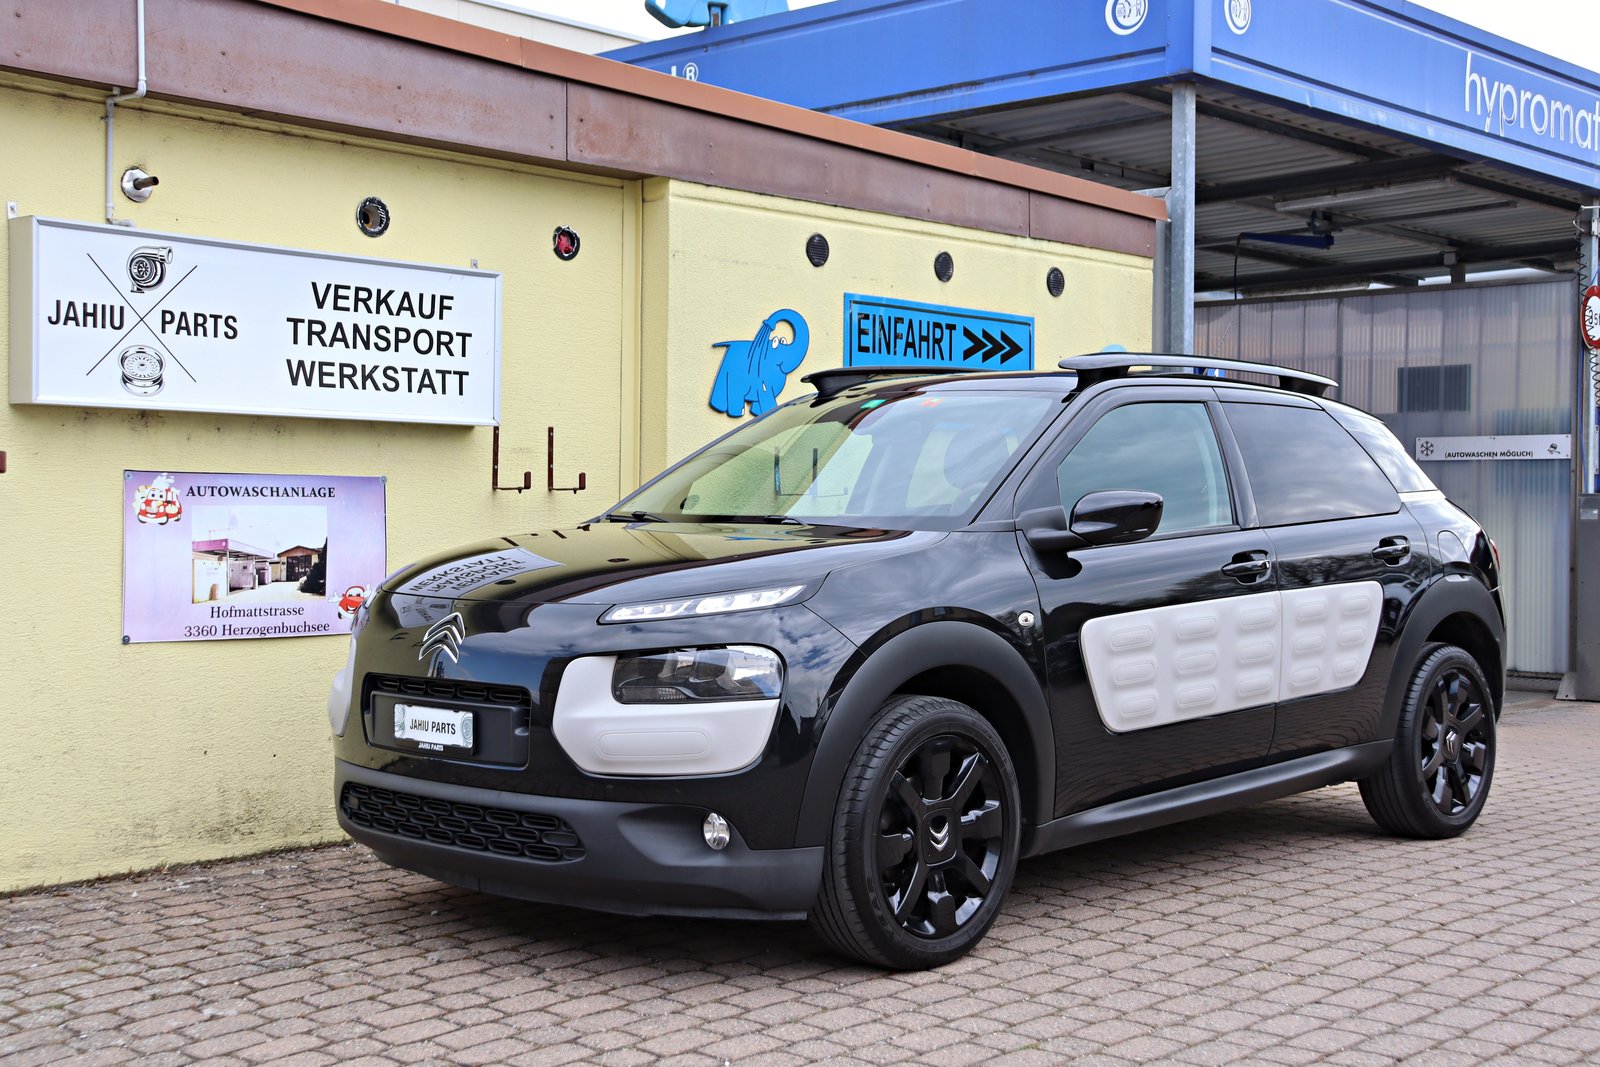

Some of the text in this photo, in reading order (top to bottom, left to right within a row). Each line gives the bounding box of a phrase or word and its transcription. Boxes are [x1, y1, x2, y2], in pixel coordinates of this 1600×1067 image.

[1464, 51, 1600, 152] hypromat
[47, 298, 238, 340] JAHIU PARTS
[311, 281, 454, 322] VERKAUF
[286, 317, 474, 358] TRANSPORT
[857, 312, 957, 362] EINFAHRT
[286, 357, 471, 397] WERKSTATT
[1445, 449, 1534, 459] (AUTOWASCHEN MÖGLICH)
[186, 485, 336, 498] AUTOWASCHANLAGE
[184, 622, 330, 638] 3360 Herzogenbuchsee
[210, 605, 305, 619] Hofmattstrasse
[409, 718, 456, 735] JAHIU PARTS
